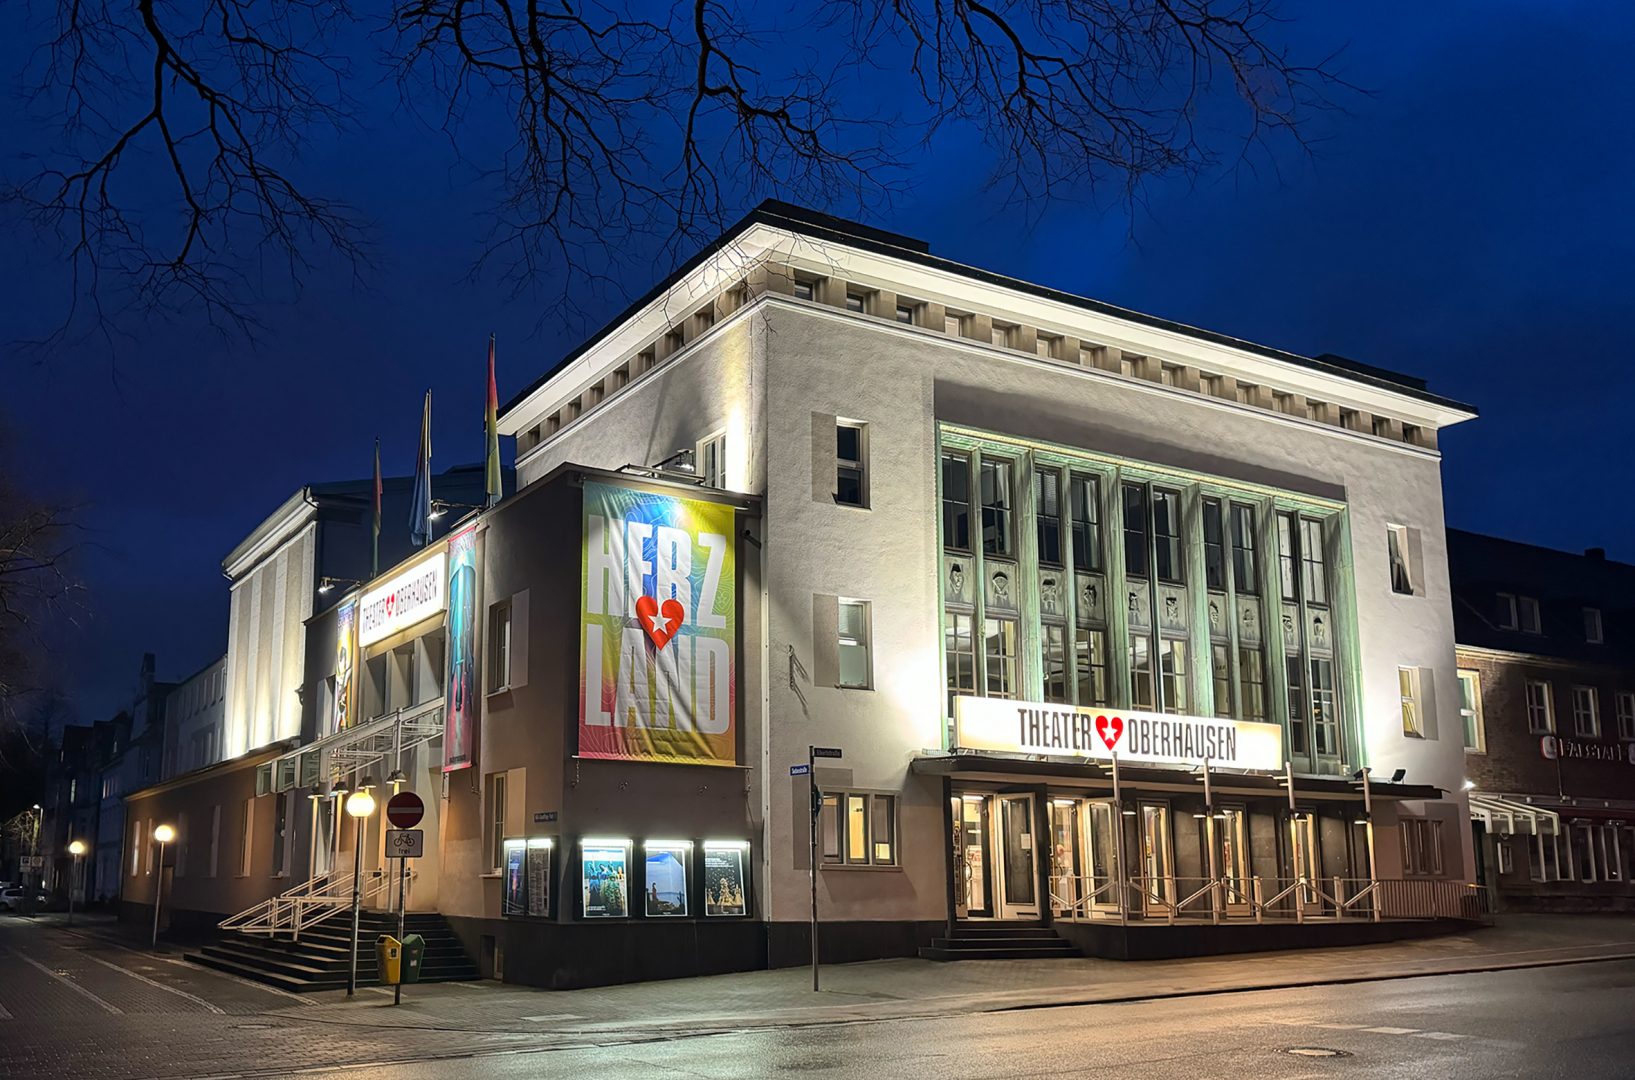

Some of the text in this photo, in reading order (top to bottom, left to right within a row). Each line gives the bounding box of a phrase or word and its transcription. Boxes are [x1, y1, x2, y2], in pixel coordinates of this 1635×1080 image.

[362, 597, 386, 634] THEATER
[395, 567, 438, 617] OBERHAUSEN
[587, 514, 727, 630] HERZ
[584, 622, 730, 735] LAND
[1017, 707, 1237, 761] THEATER OBERHAUSEN
